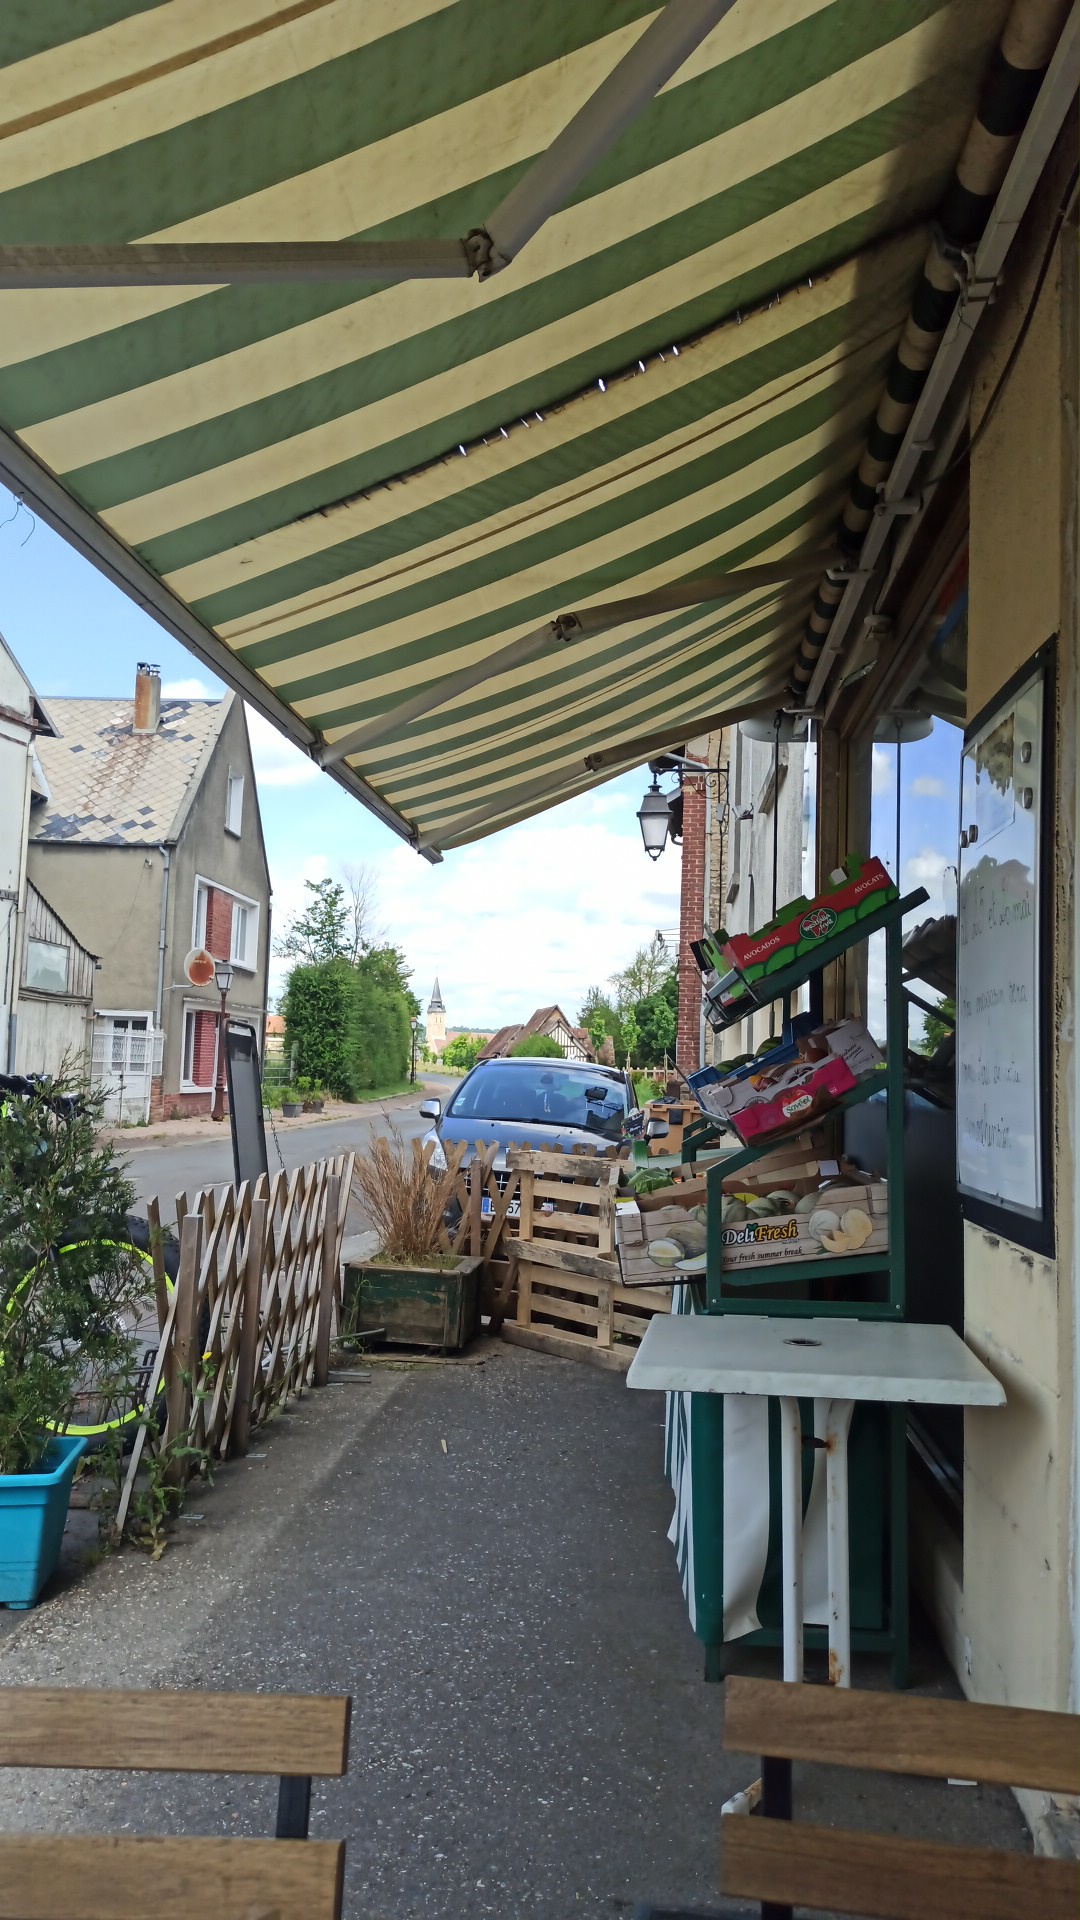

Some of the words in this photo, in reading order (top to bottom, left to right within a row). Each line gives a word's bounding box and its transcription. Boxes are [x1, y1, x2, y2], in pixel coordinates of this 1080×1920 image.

[854, 873, 885, 894] AVOCATS
[1013, 891, 1032, 922] mai
[743, 936, 781, 961] AVOCADOS
[722, 1255, 738, 1263] Your
[739, 1252, 756, 1263] fresh
[757, 1250, 783, 1259] summer
